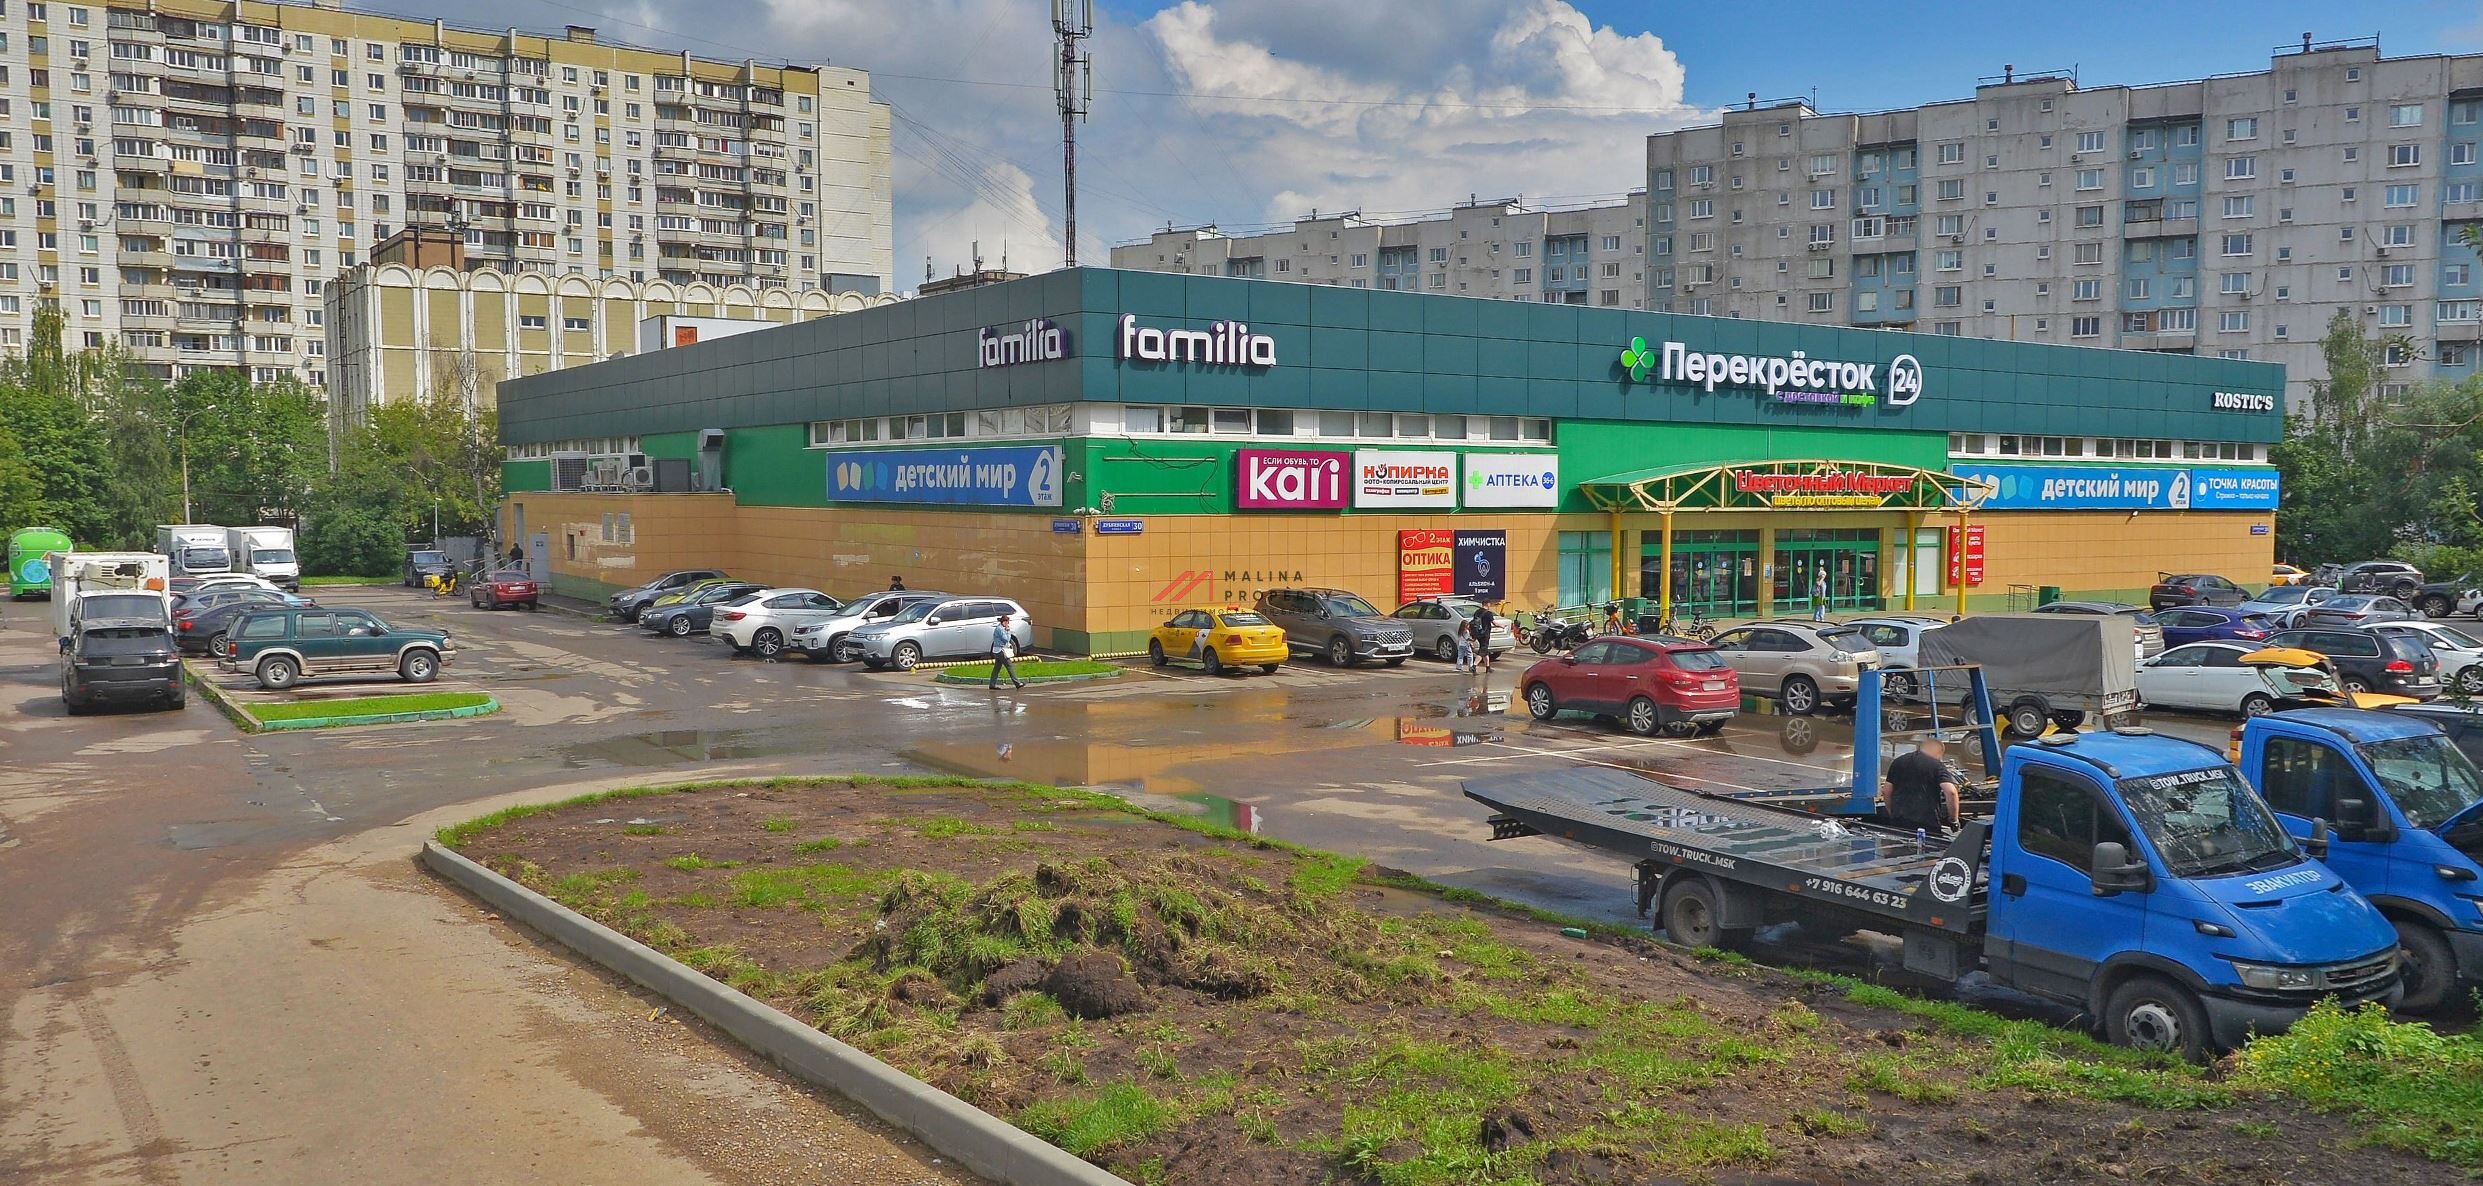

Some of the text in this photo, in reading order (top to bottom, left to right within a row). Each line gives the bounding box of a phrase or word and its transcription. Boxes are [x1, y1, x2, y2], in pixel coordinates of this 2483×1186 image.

[978, 318, 1064, 368] familia
[1119, 313, 1277, 367] familia
[1662, 341, 1918, 396] Перекрёсток 24
[2214, 392, 2274, 411] ROSTIC'S
[1263, 457, 1282, 465] ЕСЛИ
[1284, 457, 1308, 466] ОБУВЬ,
[1363, 463, 1449, 479] КОПИРКА
[895, 454, 1017, 499] детский мир
[1039, 457, 1051, 492] 2
[1249, 456, 1340, 501] kari
[1486, 474, 1539, 487] АПТЕКА
[1735, 469, 1917, 494] Цветочный Маркет
[2208, 478, 2277, 491] ТОЧКА КРАСОТЫ
[2041, 472, 2160, 505] детский мир
[2177, 477, 2186, 499] 2
[1133, 522, 1142, 530] 30
[1429, 532, 1436, 543] 2
[1458, 537, 1506, 547] ХИМЧИСТКА
[1402, 552, 1451, 566] ОПТИКА
[2149, 768, 2228, 790] @TOW_TRUCK_MSK
[1650, 841, 1737, 870] @TOW_TRUCK_MSK
[1805, 877, 1908, 910] +7 916 644 63 23
[2245, 870, 2322, 895] ЭВАКУАТОР
